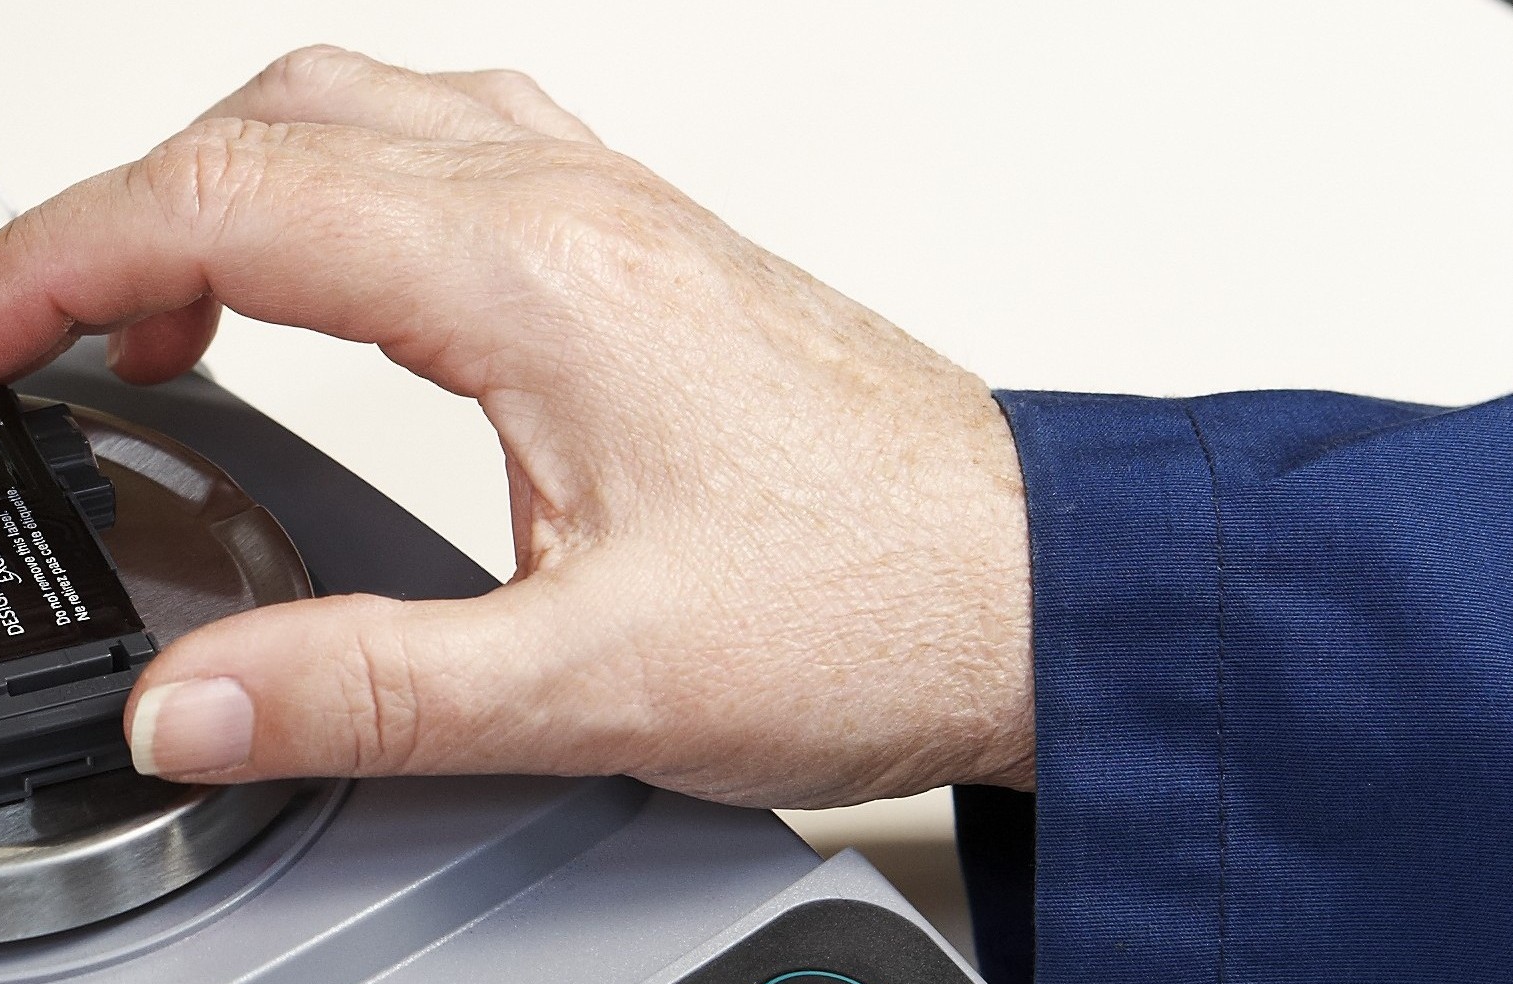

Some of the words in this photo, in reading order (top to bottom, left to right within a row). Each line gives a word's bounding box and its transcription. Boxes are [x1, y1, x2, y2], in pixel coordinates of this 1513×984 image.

[12, 537, 31, 556] this
[31, 530, 52, 556] cette
[24, 556, 52, 591] remove
[45, 556, 67, 575] pas
[56, 574, 82, 605] retirez
[42, 591, 63, 610] not
[55, 609, 72, 627] Do
[74, 604, 91, 622] Ne
